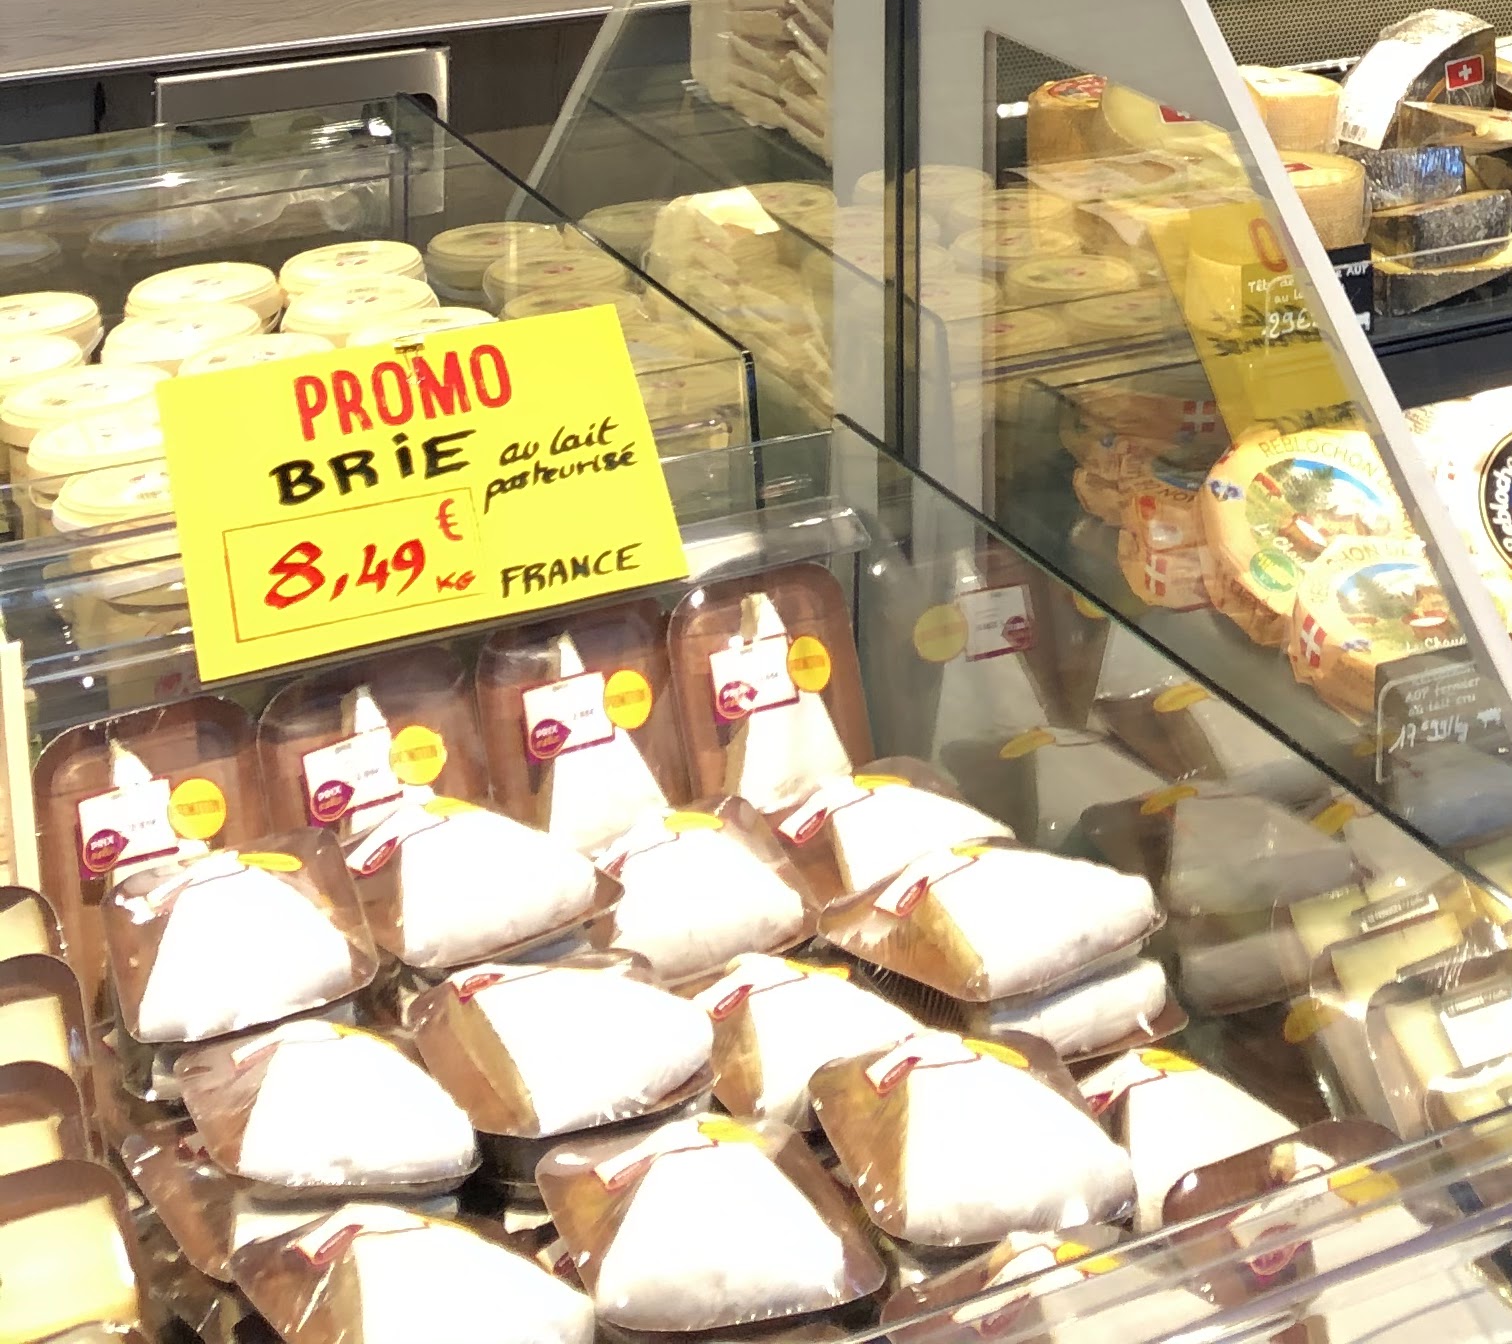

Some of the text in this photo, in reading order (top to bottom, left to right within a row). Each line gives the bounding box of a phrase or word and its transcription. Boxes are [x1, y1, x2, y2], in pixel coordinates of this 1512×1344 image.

[1274, 295, 1289, 303] au
[1280, 277, 1294, 287] de
[293, 342, 513, 442] PROMO
[499, 416, 619, 467] au lait
[483, 441, 638, 514] pasteurisé
[265, 538, 427, 610] 8,49
[500, 543, 643, 598] FRANCE
